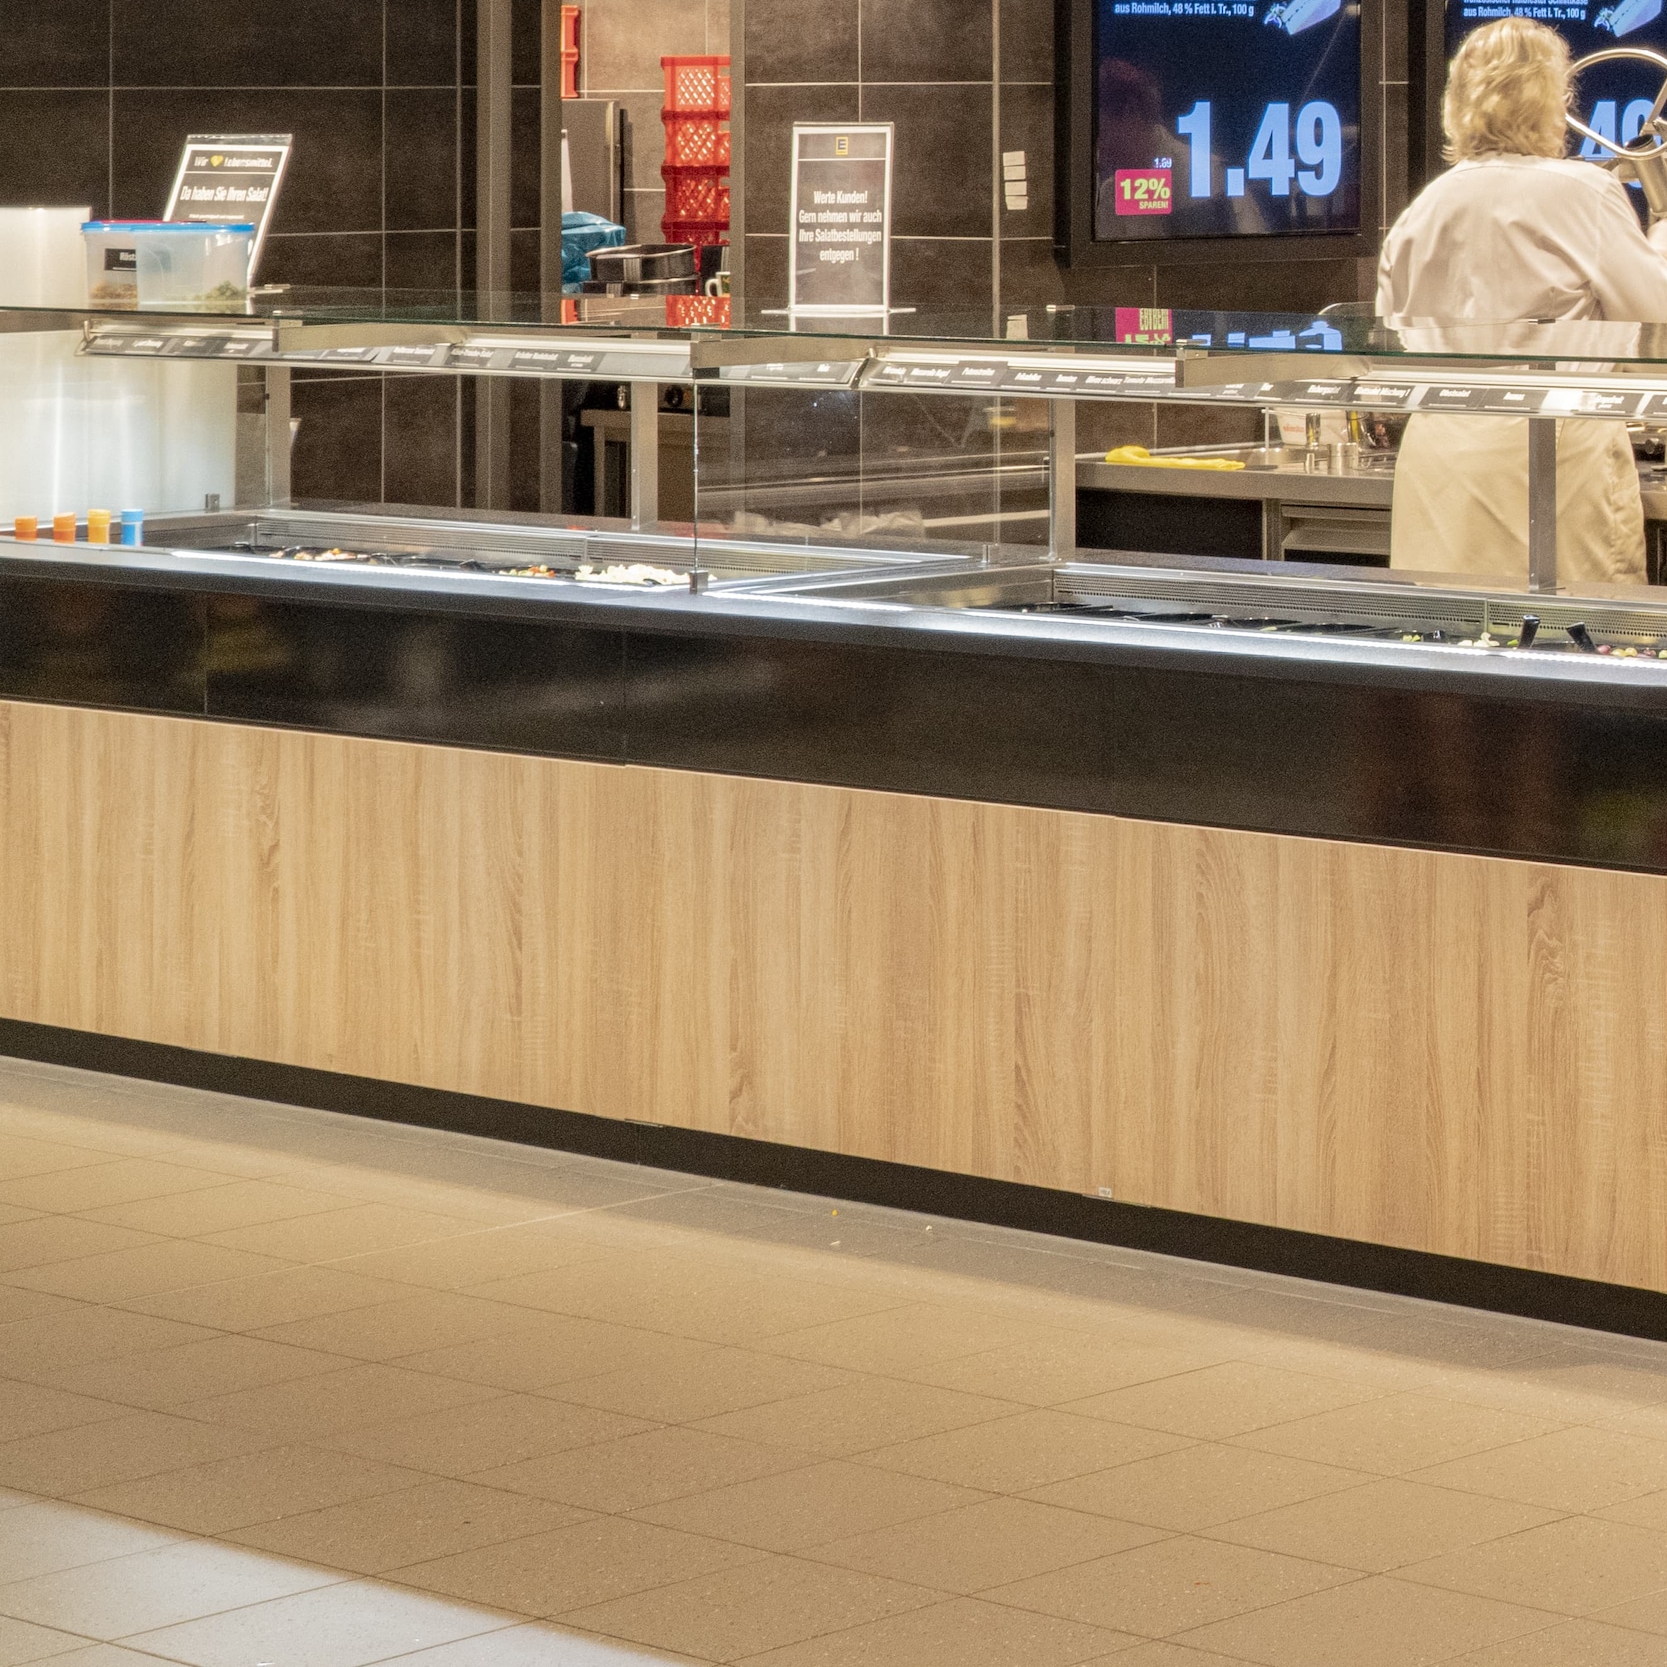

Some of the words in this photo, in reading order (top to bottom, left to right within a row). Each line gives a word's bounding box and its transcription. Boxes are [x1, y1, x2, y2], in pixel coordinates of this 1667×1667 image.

[1114, 4, 1130, 15] aus
[1131, 2, 1171, 17] Rohmilch,
[1172, 3, 1183, 15] 48
[1194, 3, 1210, 15] Fett
[1232, 4, 1246, 16] 100
[1246, 6, 1254, 18] g
[1177, 100, 1343, 198] 1.49
[180, 186, 190, 201] Da
[191, 186, 214, 202] haben
[214, 186, 227, 202] Sie
[226, 186, 247, 202] Ihren
[246, 187, 269, 203] Salat!
[1120, 178, 1170, 200] 12%
[813, 190, 836, 204] Werte
[837, 190, 868, 205] Kunden!
[1139, 200, 1169, 210] SPAREN!
[799, 209, 817, 224] Gern
[817, 209, 848, 224] nehmen
[848, 210, 862, 223] wir
[863, 209, 882, 224] auch
[799, 228, 814, 243] Ihre
[815, 228, 882, 245] Salatbestellungen
[819, 248, 855, 264] entgegen
